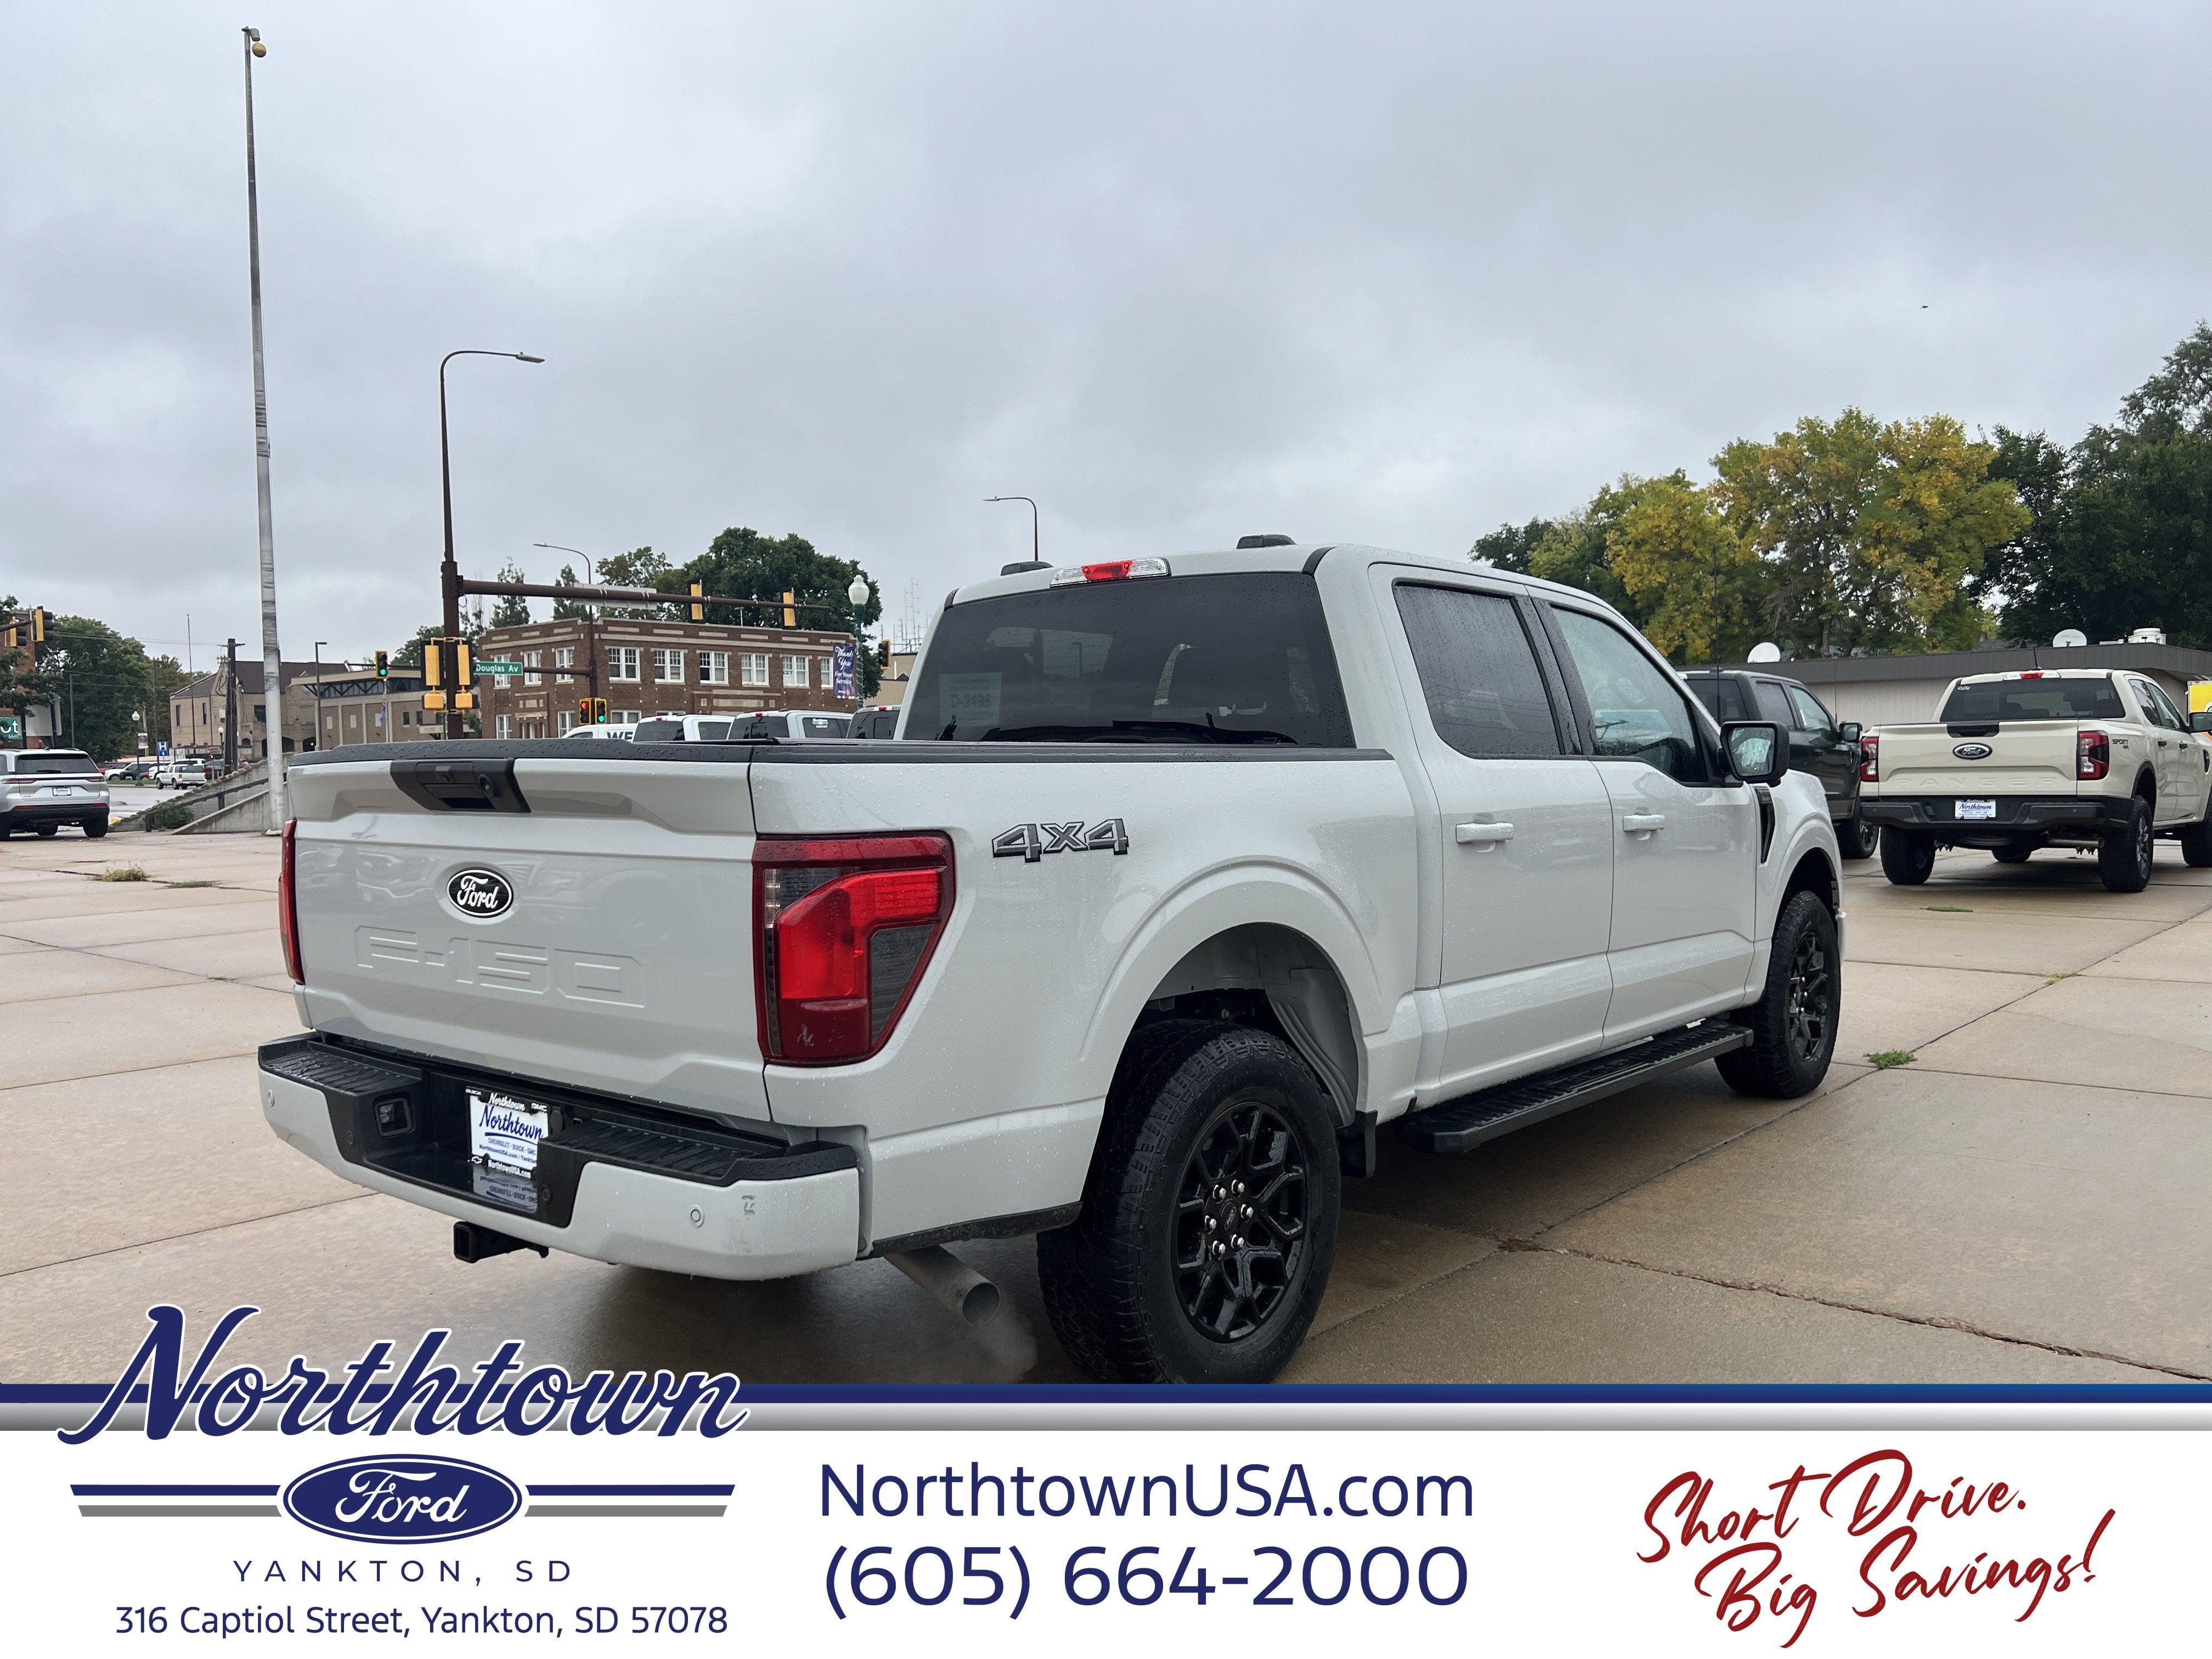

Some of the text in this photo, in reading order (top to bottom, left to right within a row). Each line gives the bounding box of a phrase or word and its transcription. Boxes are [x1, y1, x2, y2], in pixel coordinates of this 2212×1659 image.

[835, 646, 854, 658] Thank
[476, 664, 518, 674] Douglas Av
[838, 657, 852, 670] You
[159, 742, 167, 751] H
[1894, 776, 2058, 788] RANGER
[456, 874, 499, 909] Ford
[354, 925, 645, 1008] F-150
[488, 1092, 526, 1111] Northtown
[530, 1102, 548, 1112] GMC
[479, 1104, 543, 1139] Northtown
